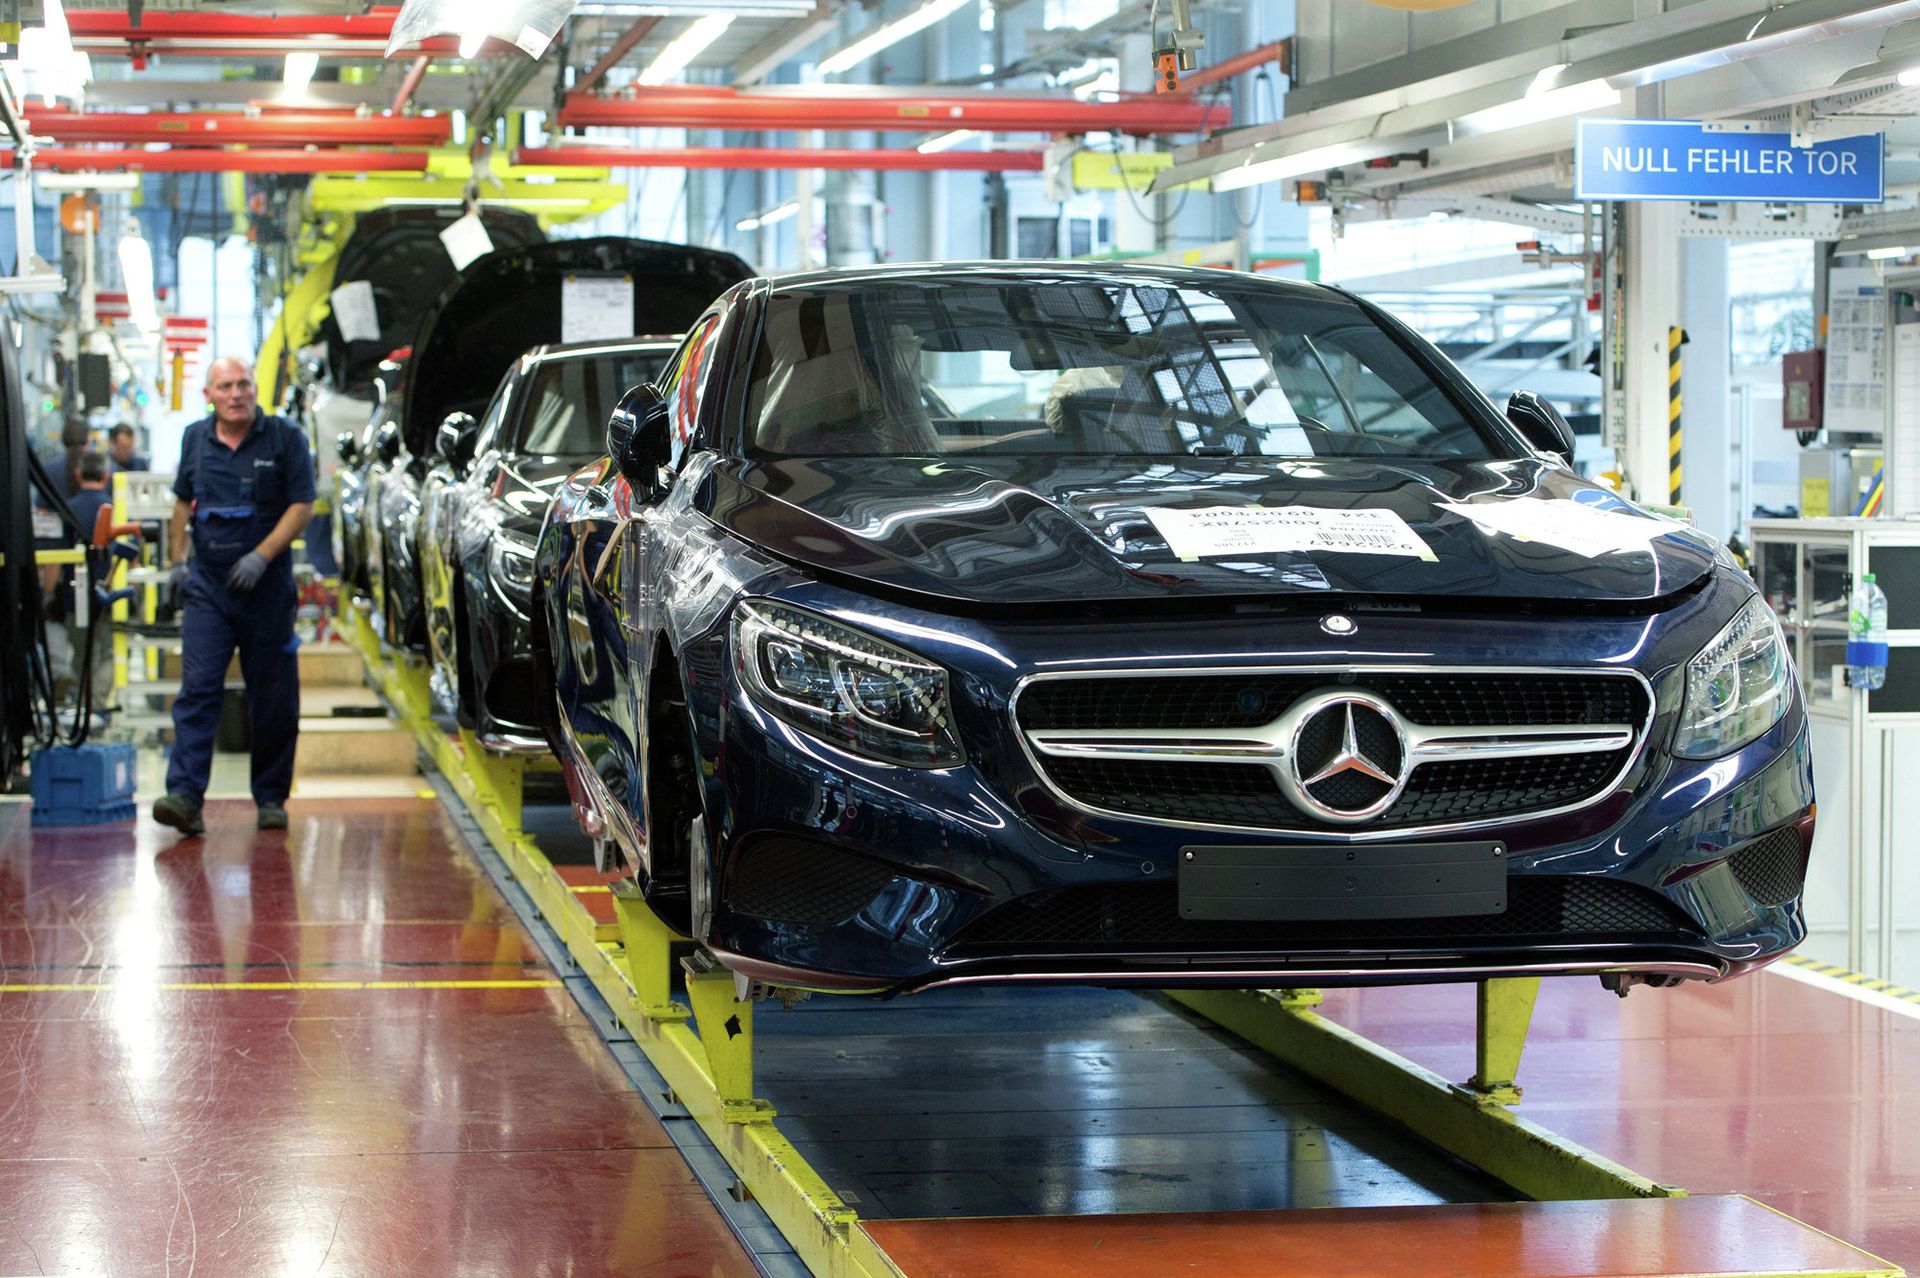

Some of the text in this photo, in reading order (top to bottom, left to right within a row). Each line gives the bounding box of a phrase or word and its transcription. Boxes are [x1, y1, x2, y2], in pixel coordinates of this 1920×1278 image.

[1602, 145, 1858, 175] NULL FEHLER TOR
